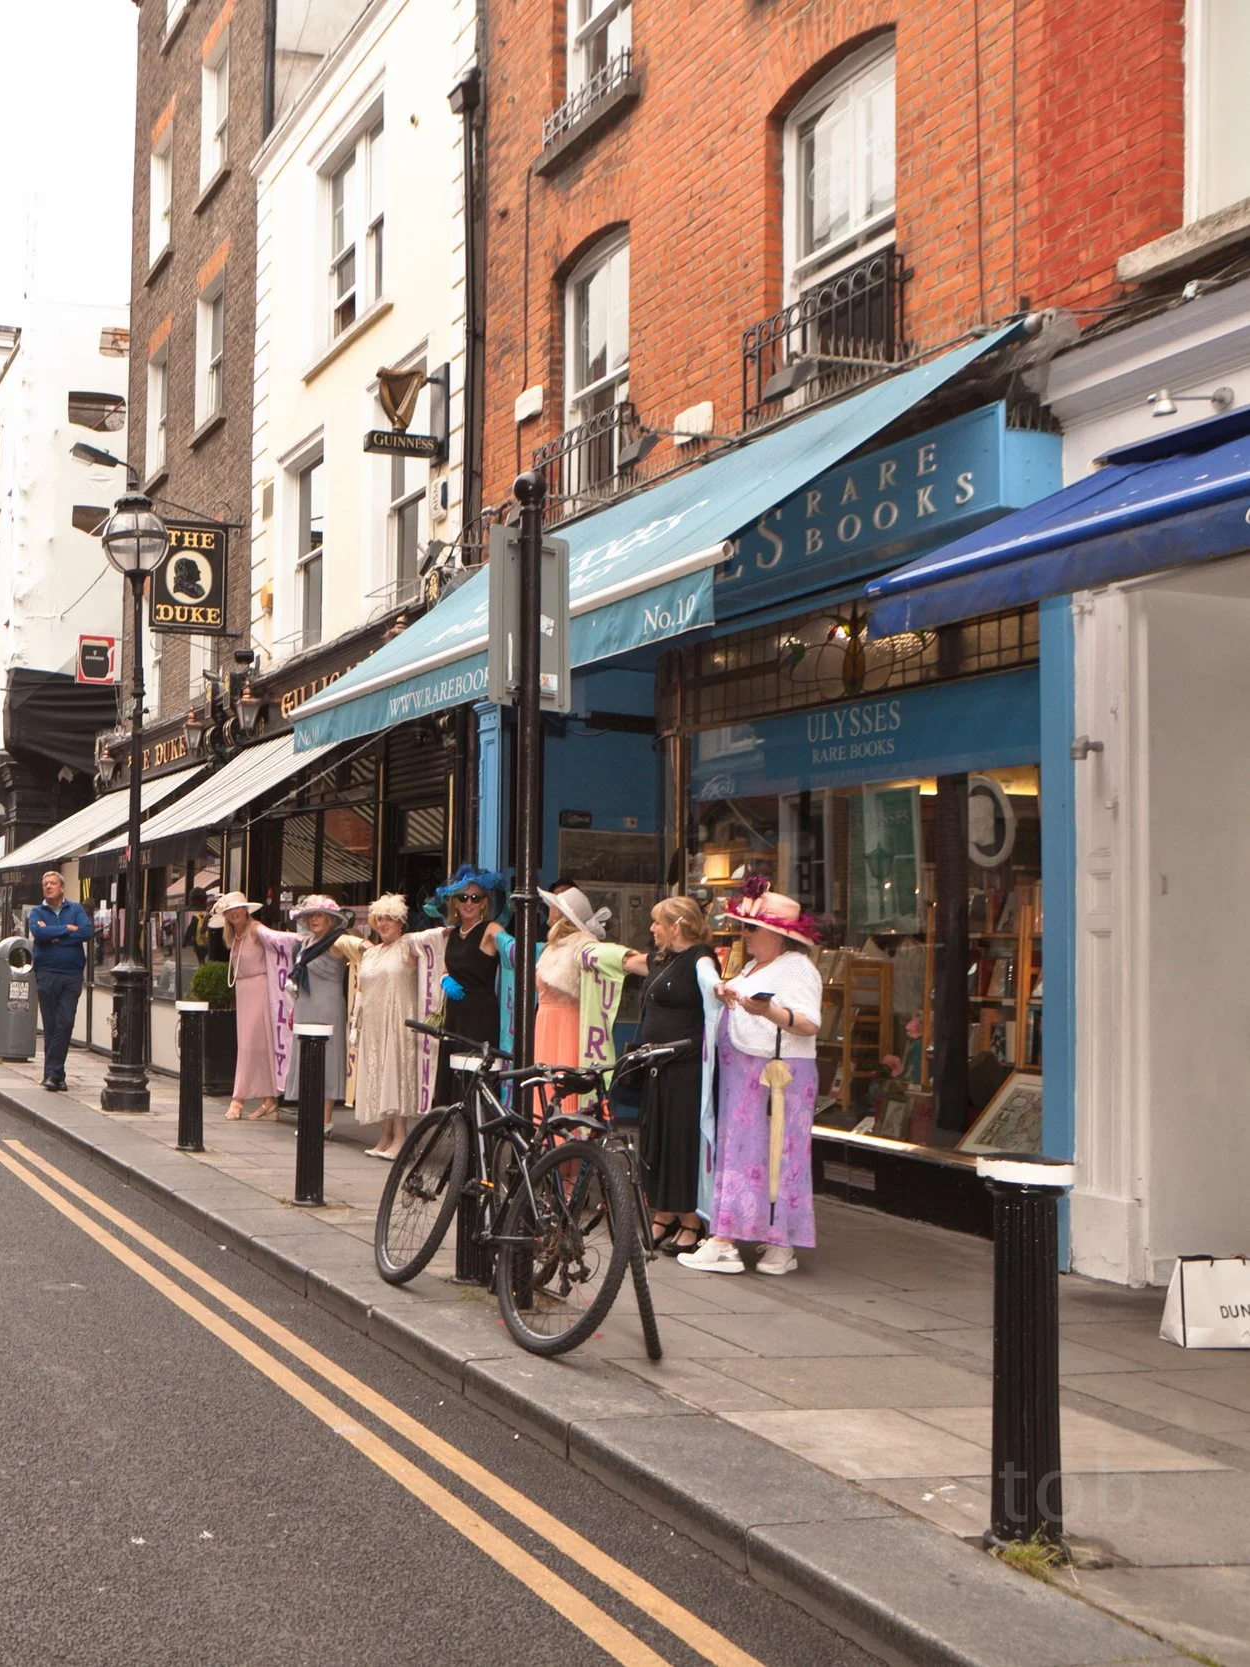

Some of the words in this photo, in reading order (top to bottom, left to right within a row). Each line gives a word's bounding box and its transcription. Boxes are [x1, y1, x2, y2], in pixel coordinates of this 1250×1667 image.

[373, 432, 434, 450] GUINNESS
[806, 442, 937, 518] RARE
[805, 471, 974, 556] BOOKS
[166, 530, 215, 549] THE
[156, 604, 221, 624] DUKE
[643, 594, 696, 635] No.10
[807, 700, 901, 742] ULYSSES
[155, 735, 187, 767] DUKE
[812, 746, 847, 764] RARE
[850, 738, 895, 759] BOOKS
[272, 943, 289, 1076] MOLLY
